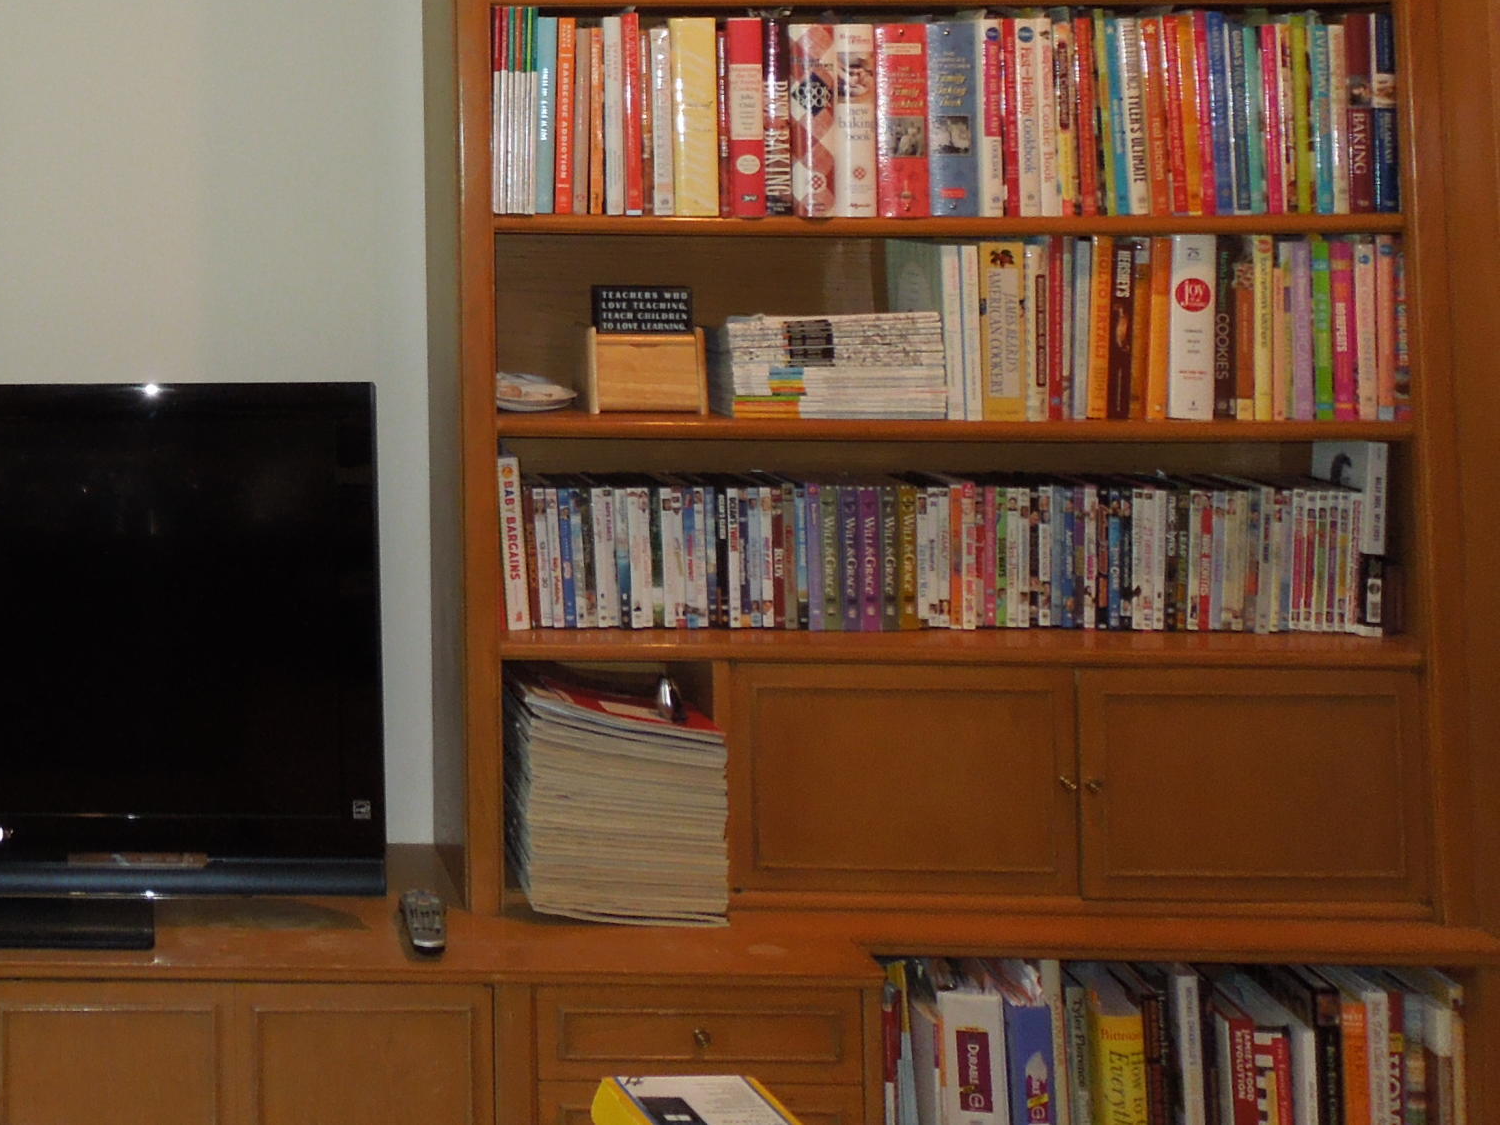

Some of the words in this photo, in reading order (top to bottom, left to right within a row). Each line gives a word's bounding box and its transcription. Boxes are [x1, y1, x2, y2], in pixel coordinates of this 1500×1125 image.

[1232, 30, 1243, 65] GIADA'S
[561, 63, 570, 118] BARBECUE
[1128, 95, 1144, 133] TYLER'S
[560, 121, 569, 178] ADDICTION
[766, 130, 790, 196] BAKING
[1132, 137, 1147, 183] ULTIMATE
[1154, 141, 1165, 180] kitchen
[1353, 113, 1367, 174] BAKING
[1116, 250, 1132, 298] HERSHEY'S
[602, 291, 658, 299] TEACHERS
[987, 270, 1002, 336] AMERICAN
[1004, 293, 1017, 326] JAMES
[602, 322, 614, 330] TO
[617, 322, 638, 330] LOVE
[638, 312, 687, 320] CHILDREN
[1005, 328, 1018, 373] BEARD'S
[1216, 313, 1230, 380] COOKIES
[989, 338, 1003, 395] COOKERY
[503, 481, 517, 513] BABY
[730, 497, 738, 525] OCEAN'S
[506, 517, 521, 580] BARGAINS
[1166, 531, 1177, 556] lyrics
[774, 548, 784, 579] RUDY
[1073, 999, 1085, 1031] Tyler
[1075, 1034, 1086, 1088] Florence
[1235, 1031, 1246, 1099] REVOLUTION
[1242, 1029, 1253, 1068] JAMIE'S
[1131, 1051, 1144, 1089] How
[1246, 1072, 1255, 1101] FOOD
[1134, 1097, 1144, 1113] to
